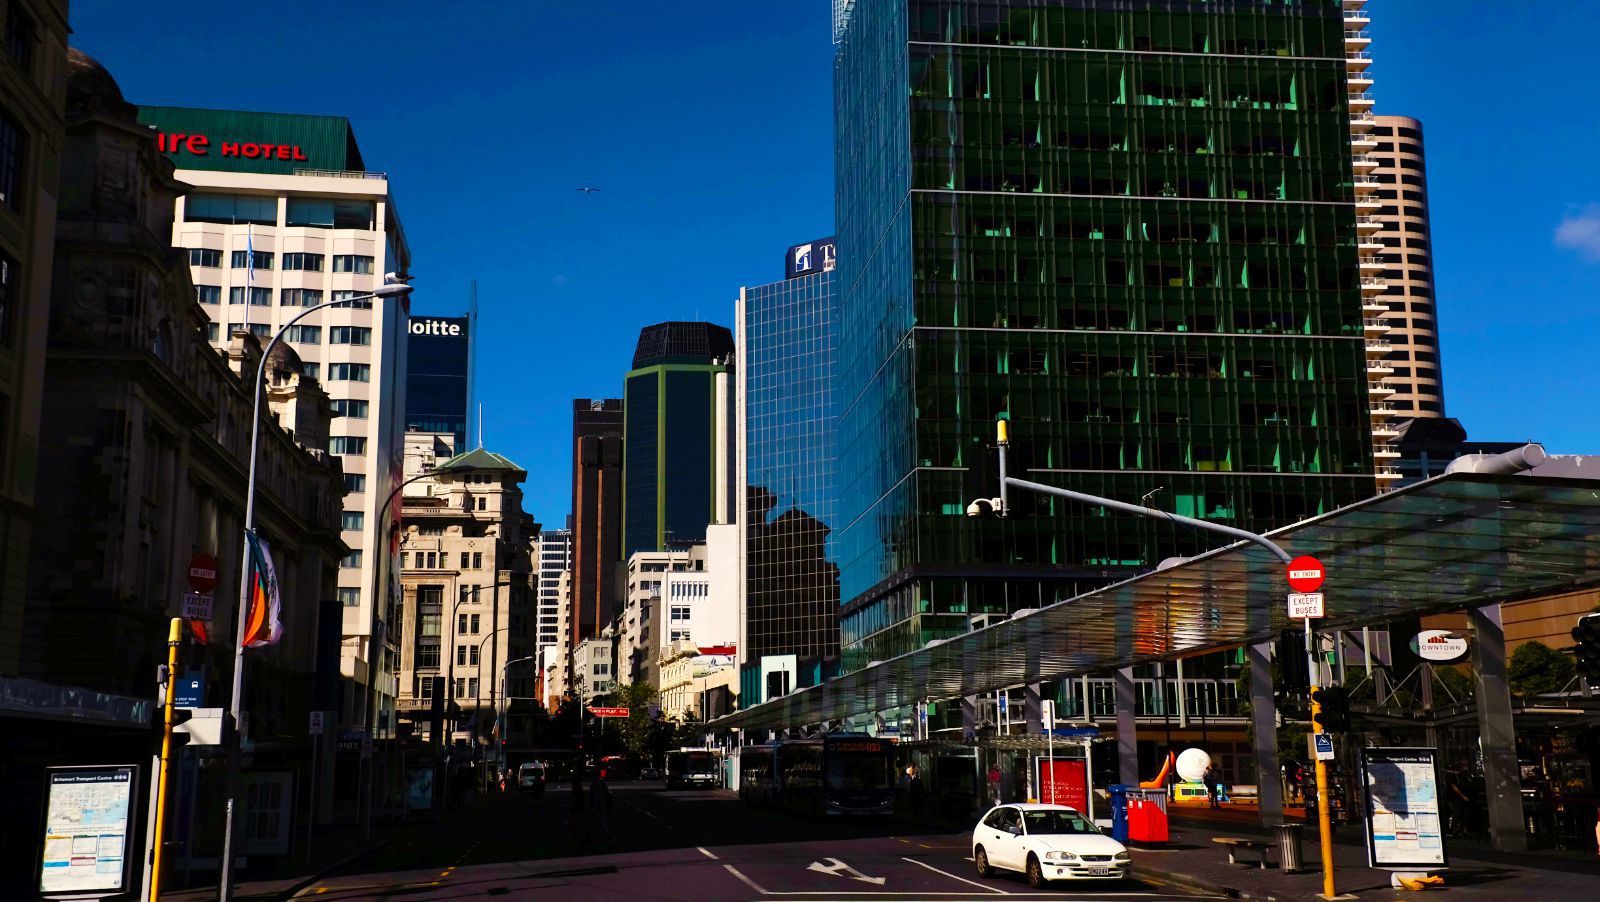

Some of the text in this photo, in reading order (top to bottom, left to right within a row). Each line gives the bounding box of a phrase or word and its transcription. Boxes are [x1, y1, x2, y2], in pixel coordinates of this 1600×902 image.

[222, 141, 307, 161] HOTEL
[187, 596, 210, 606] EXCEPT
[1293, 597, 1318, 606] EXCEPT
[188, 606, 208, 616] BUSES
[1295, 607, 1318, 615] BUSES
